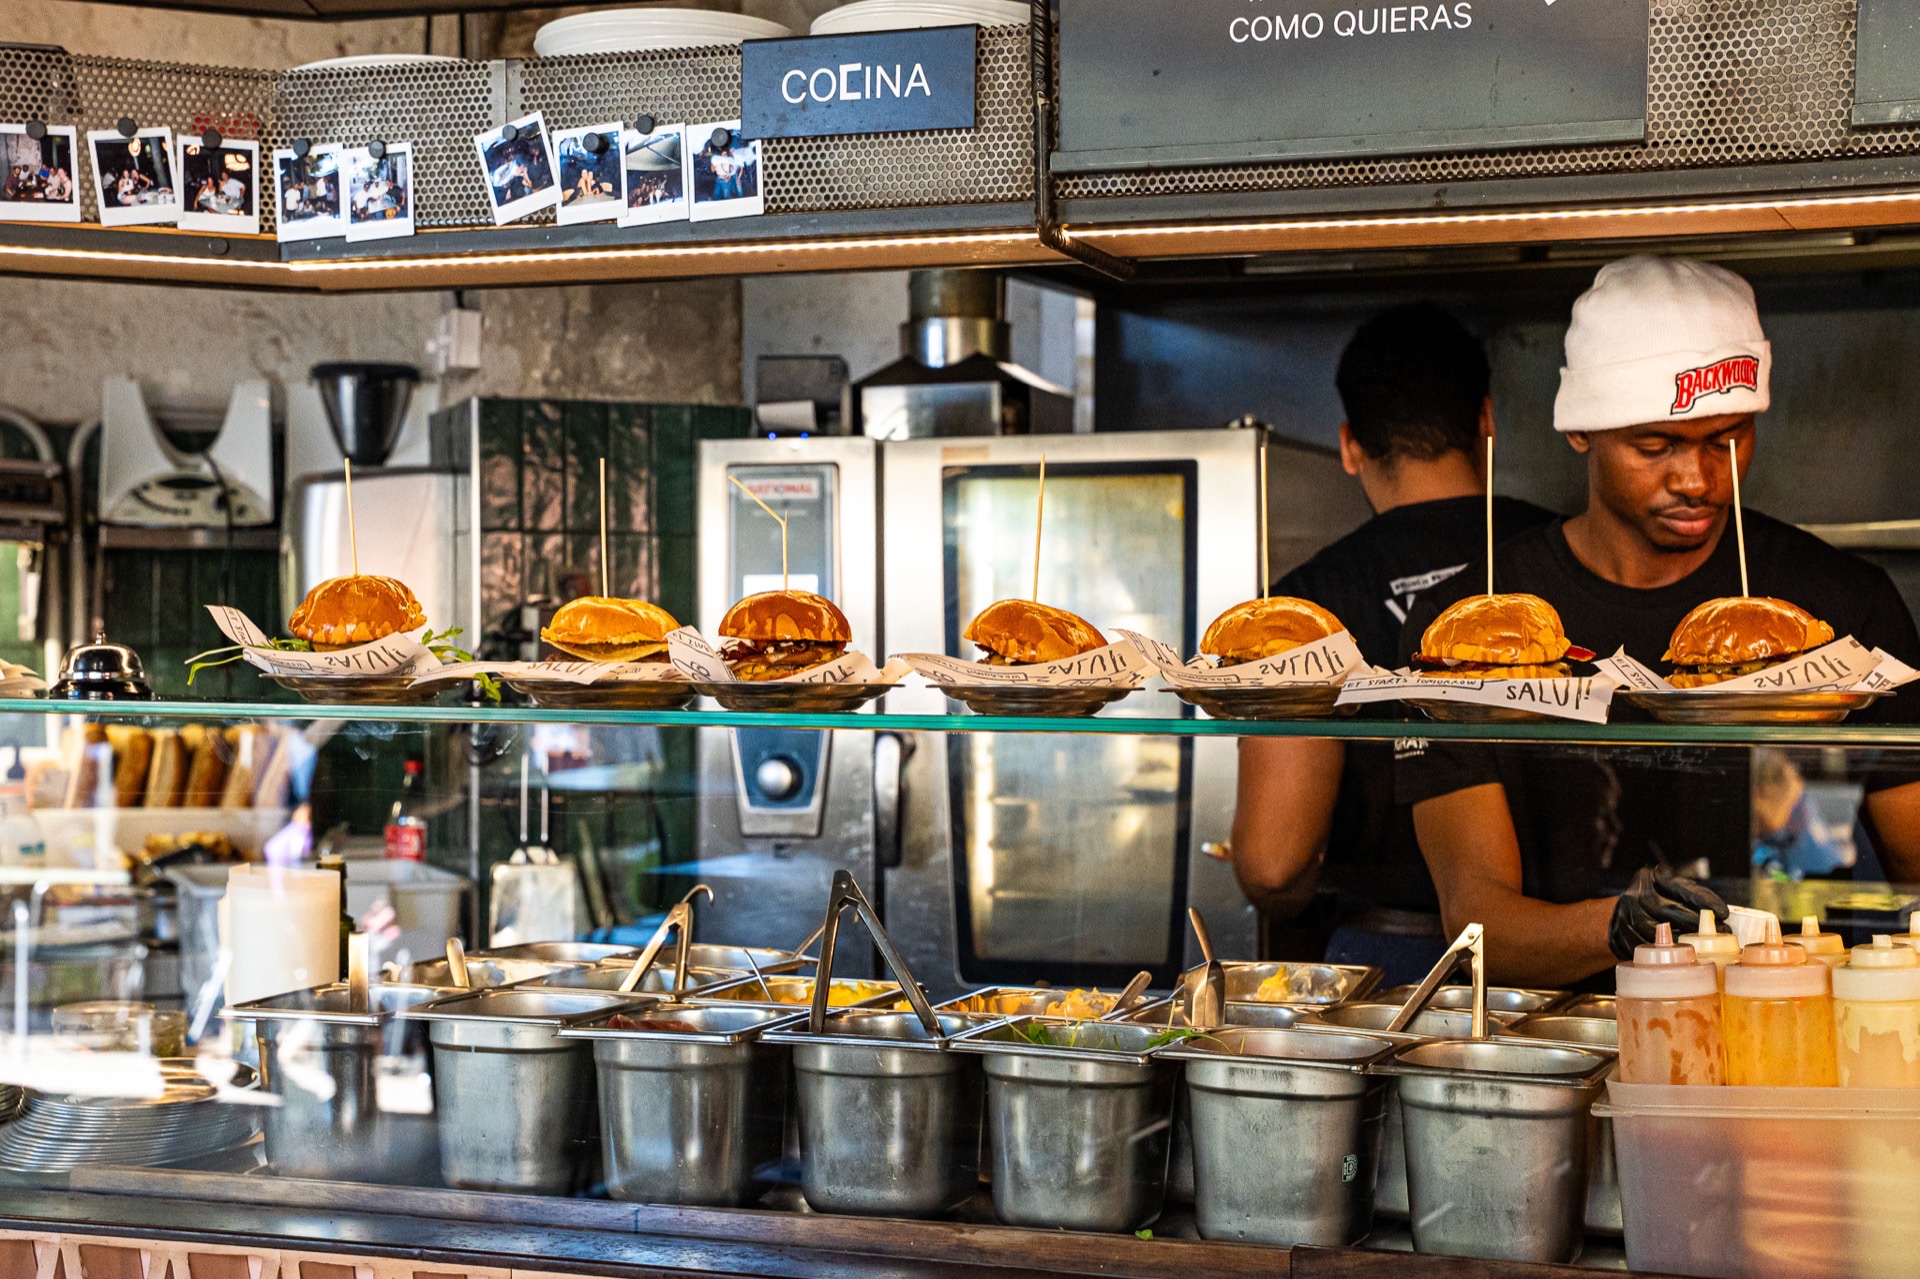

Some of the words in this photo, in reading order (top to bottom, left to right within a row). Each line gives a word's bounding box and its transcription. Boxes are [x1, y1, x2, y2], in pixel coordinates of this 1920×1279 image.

[1229, 12, 1324, 43] COMO
[1333, 2, 1473, 37] QUIERAS
[781, 62, 932, 104] COCINA
[1672, 357, 1759, 411] BACKWOODS
[1367, 677, 1408, 686] STARTS
[1416, 678, 1477, 686] TOMORROW
[1506, 677, 1592, 710] SALUT!
